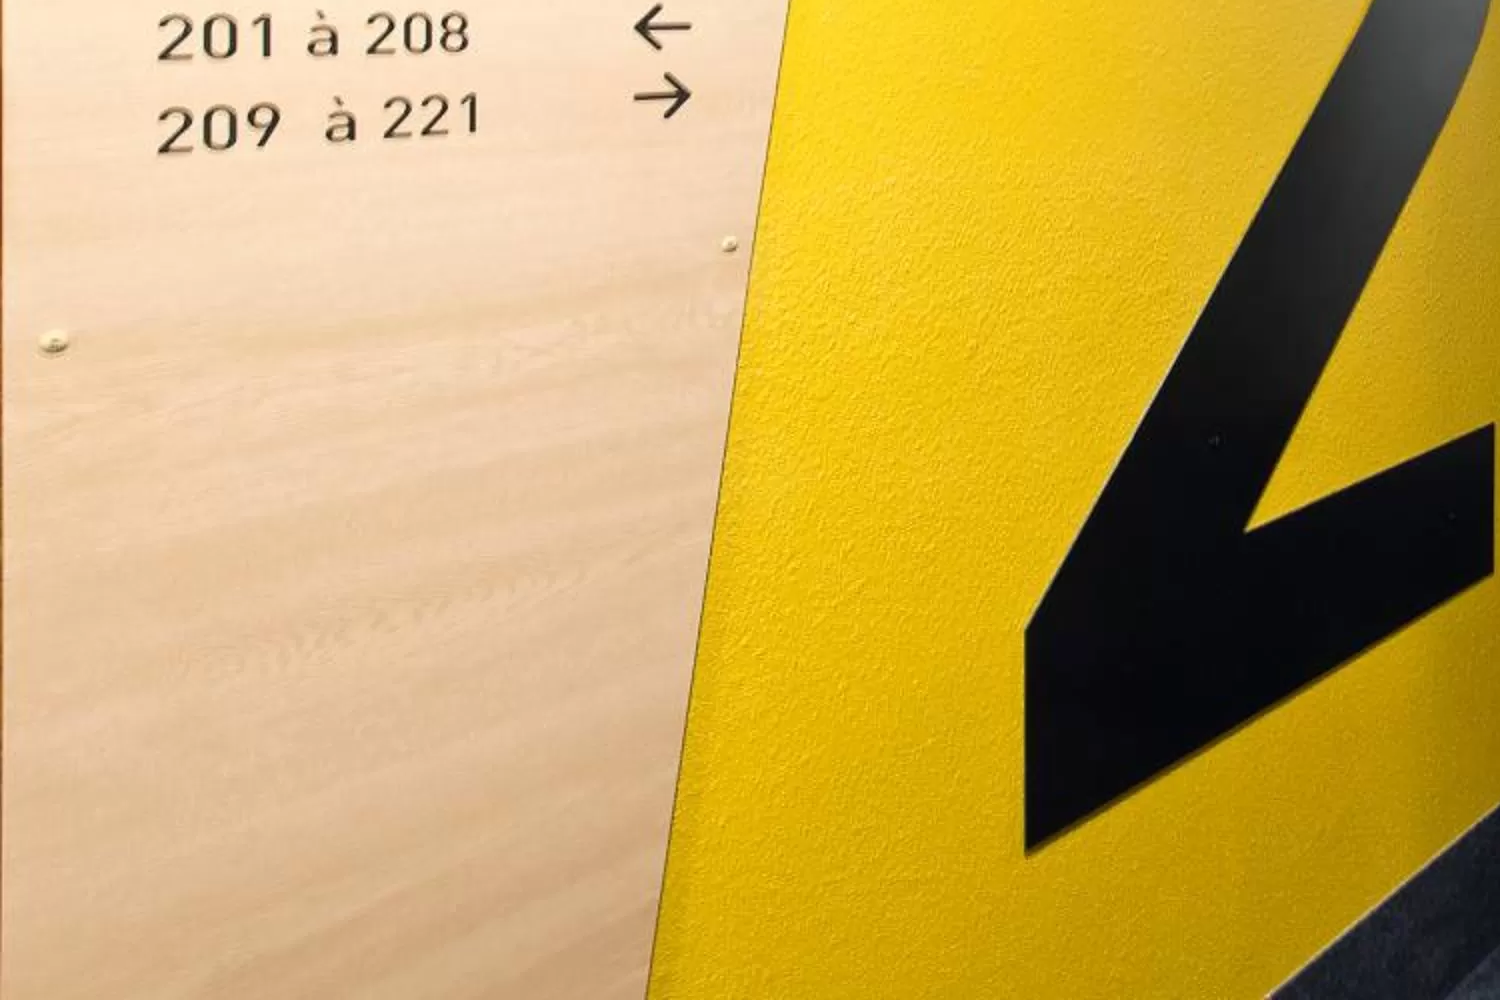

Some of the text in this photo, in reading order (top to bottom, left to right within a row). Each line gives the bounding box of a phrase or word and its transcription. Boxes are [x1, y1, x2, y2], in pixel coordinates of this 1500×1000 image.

[156, 9, 470, 61] 201 à 208
[156, 91, 478, 156] 209 à 221
